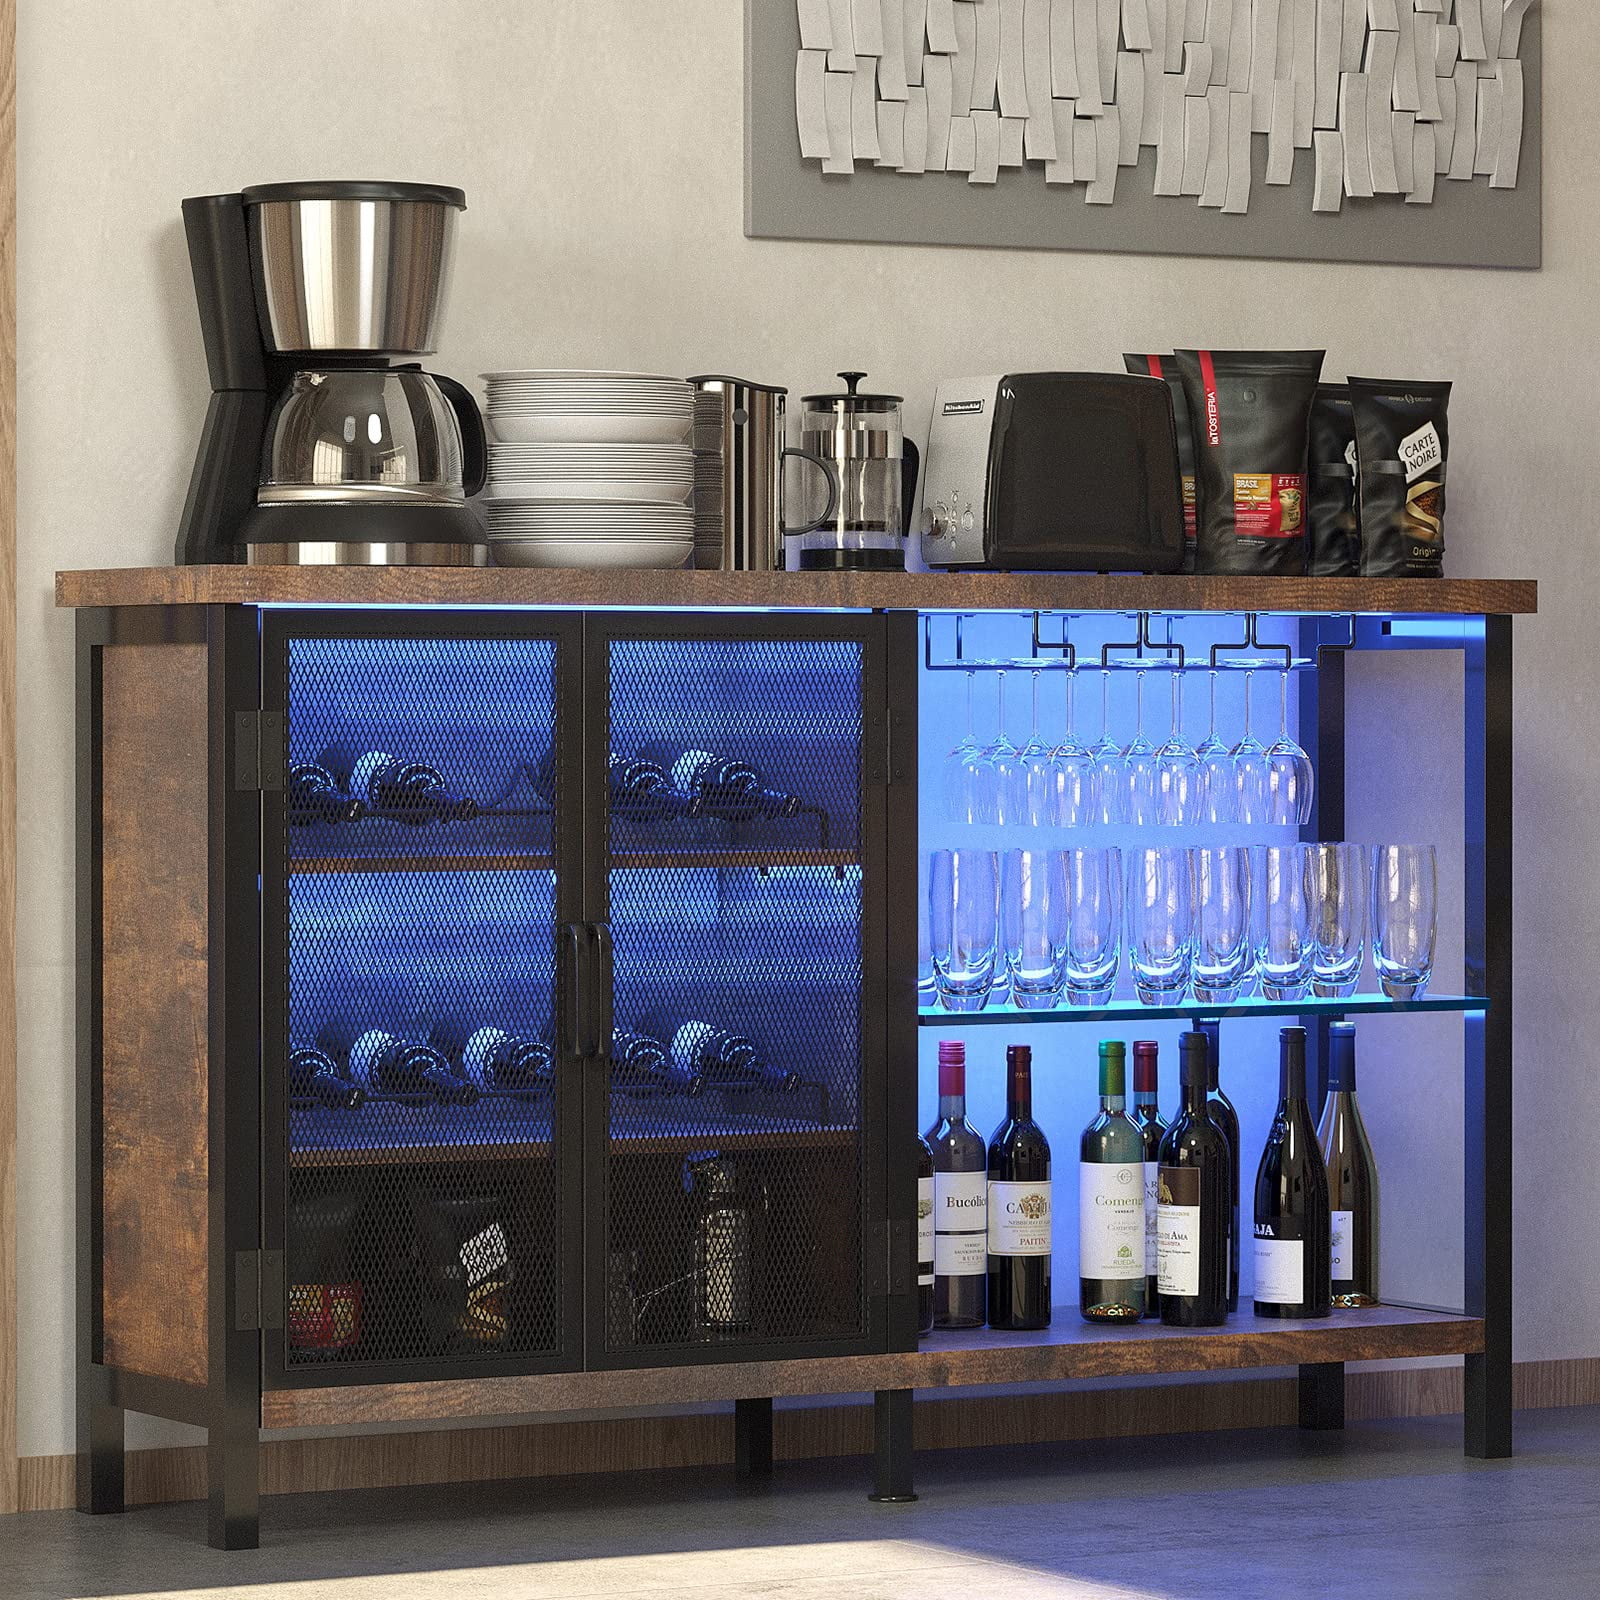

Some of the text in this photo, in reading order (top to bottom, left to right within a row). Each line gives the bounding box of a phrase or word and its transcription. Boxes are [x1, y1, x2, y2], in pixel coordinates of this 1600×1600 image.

[1206, 391, 1219, 445] laTOSTERIA
[1404, 432, 1435, 458] CARTE
[1408, 446, 1438, 472] NOIRE
